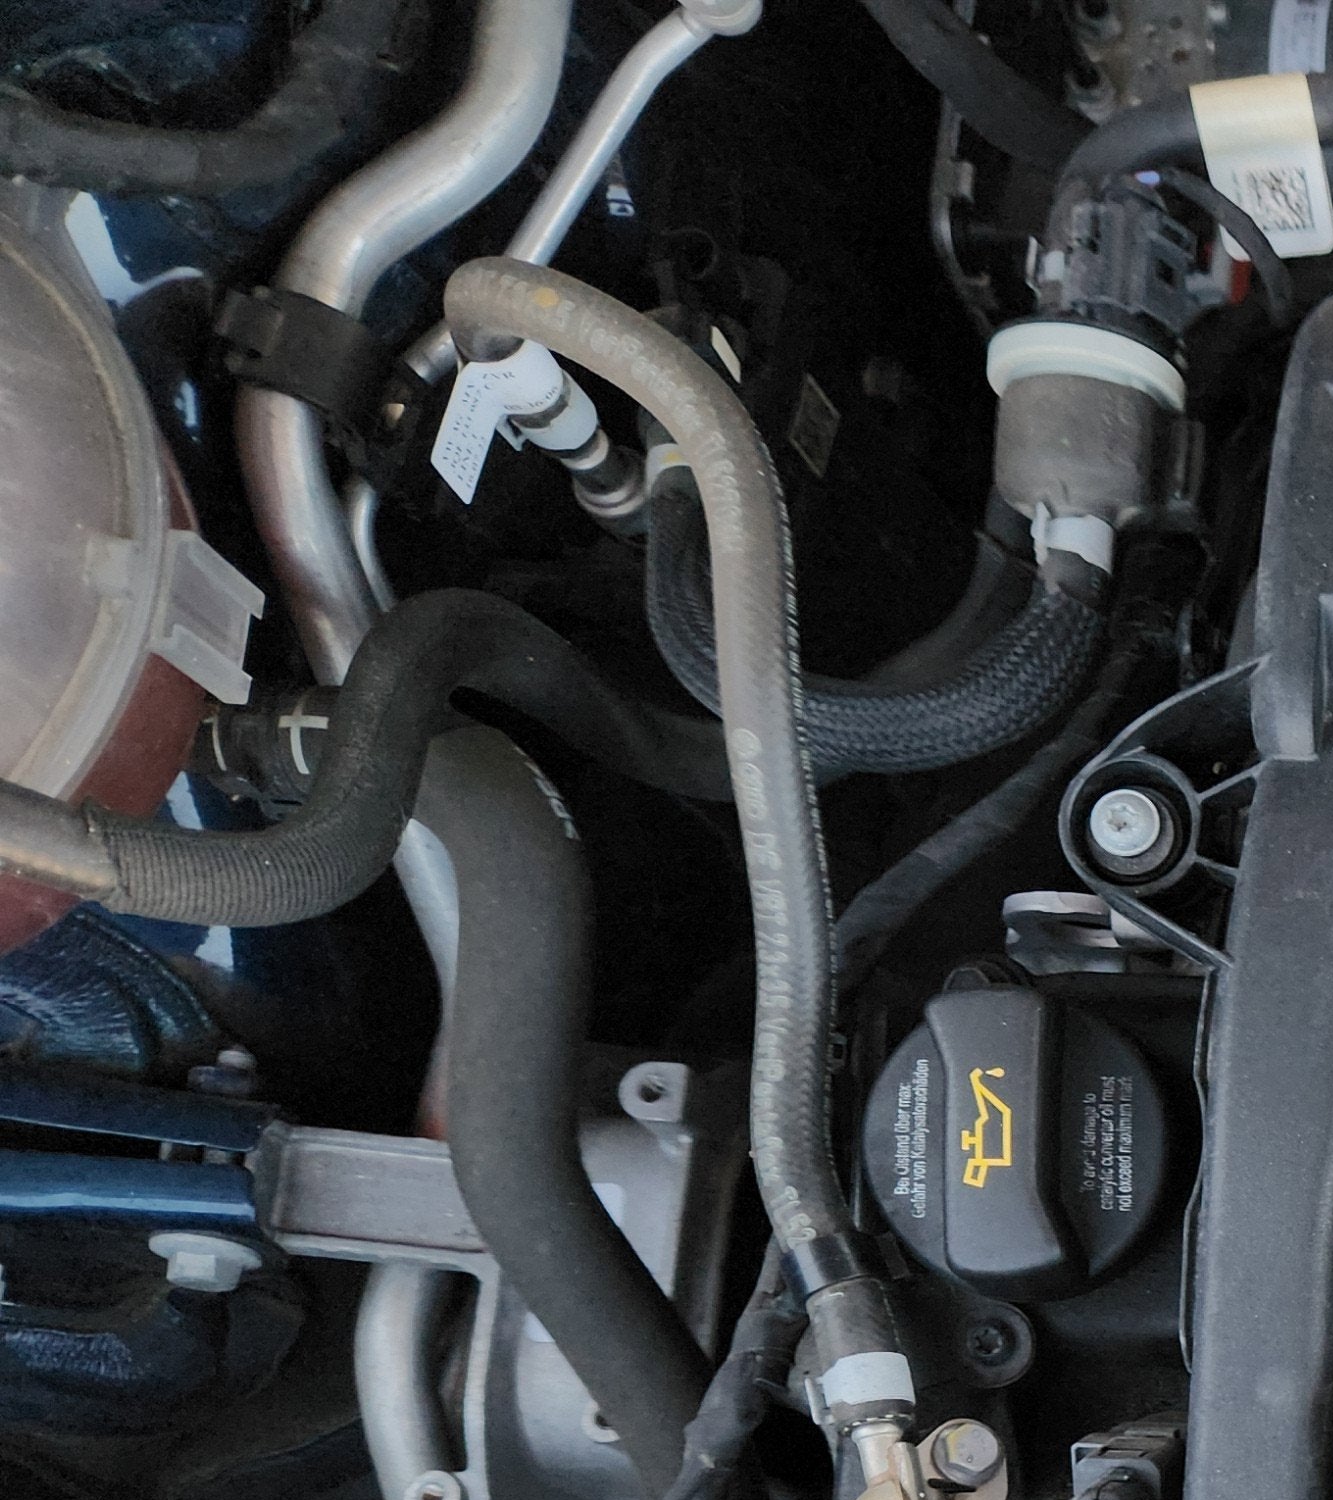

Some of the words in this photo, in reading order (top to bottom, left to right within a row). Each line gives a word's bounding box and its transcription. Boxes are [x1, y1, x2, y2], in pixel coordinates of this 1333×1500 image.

[1082, 1093, 1096, 1103] to
[1100, 1076, 1115, 1101] must
[1117, 1076, 1132, 1101] mark
[894, 1109, 910, 1133] über
[911, 1059, 929, 1158] Katalysatorschäden
[1098, 1104, 1113, 1116] oil
[1080, 1106, 1099, 1146] damage
[1116, 1104, 1132, 1153] maximum
[1100, 1118, 1114, 1166] converter
[914, 1161, 926, 1180] von
[1116, 1155, 1132, 1192] exceed
[894, 1177, 909, 1195] Bei
[1098, 1168, 1117, 1210] catalytic
[911, 1183, 926, 1218] Gefahr
[1116, 1195, 1132, 1211] not
